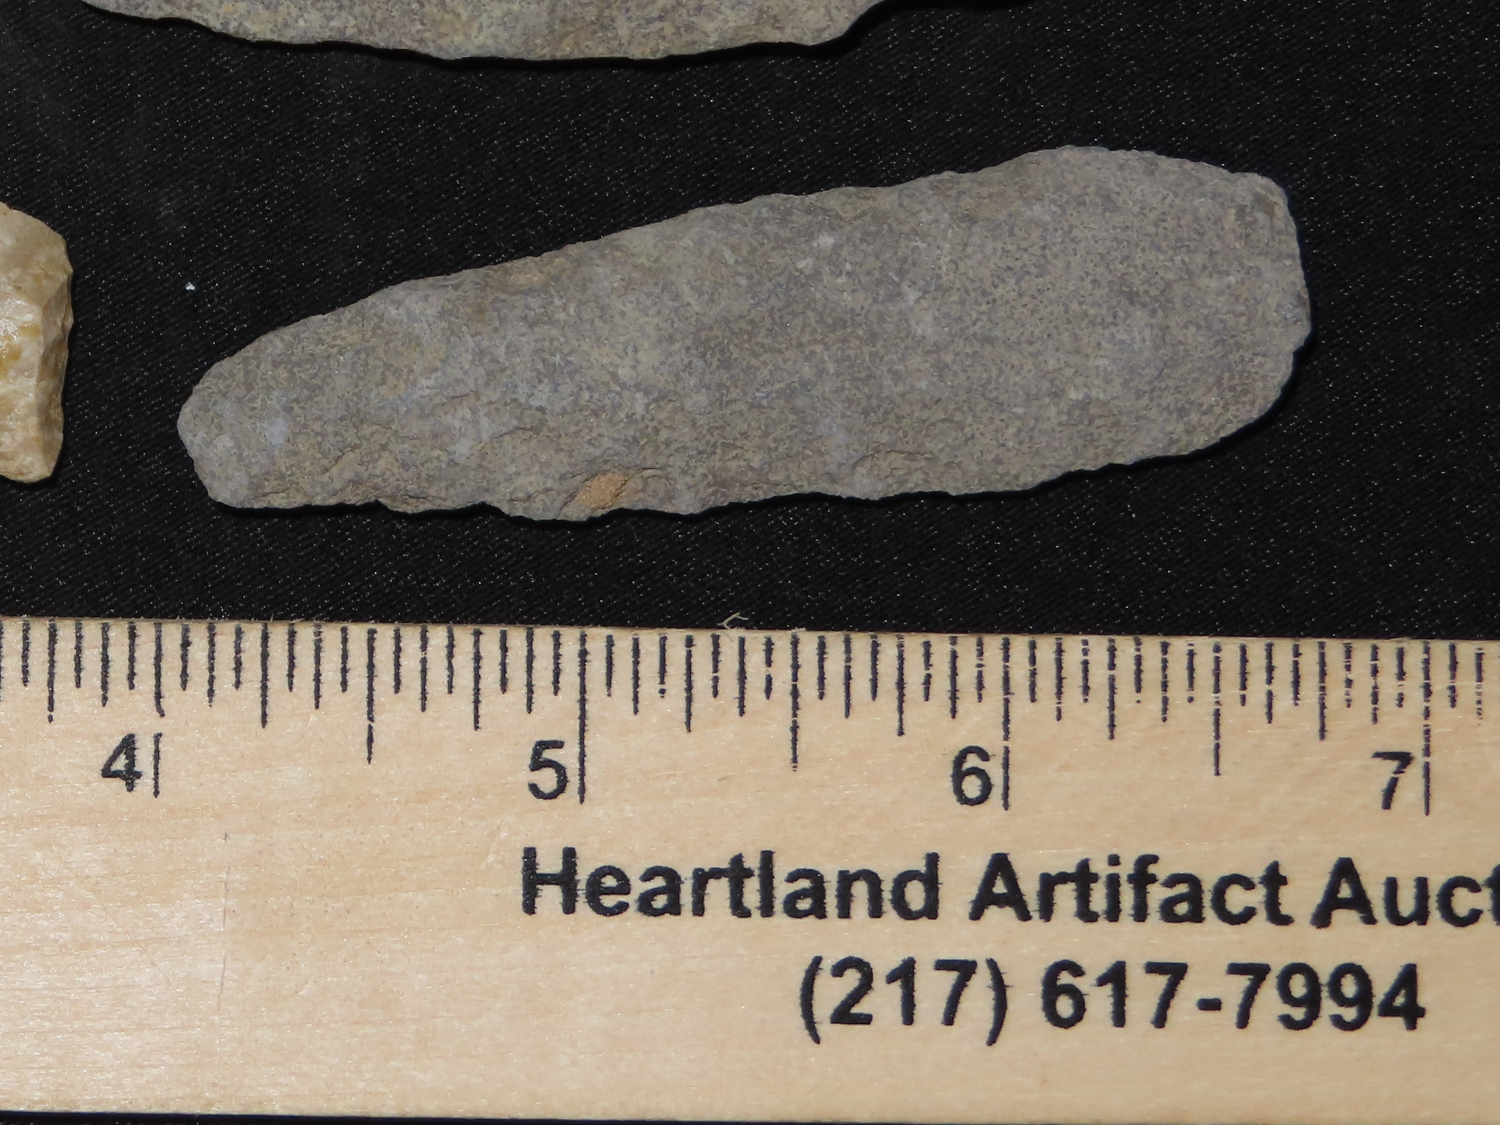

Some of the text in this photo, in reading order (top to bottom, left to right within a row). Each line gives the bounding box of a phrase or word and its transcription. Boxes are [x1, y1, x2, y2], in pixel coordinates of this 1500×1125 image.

[100, 733, 143, 792] 4
[527, 739, 569, 801] 5
[950, 745, 994, 807] 6
[1370, 751, 1414, 811] 7
[520, 846, 942, 921] Heartland
[968, 852, 1295, 927] Artifact
[799, 955, 1428, 1046] (217) 617-7994
